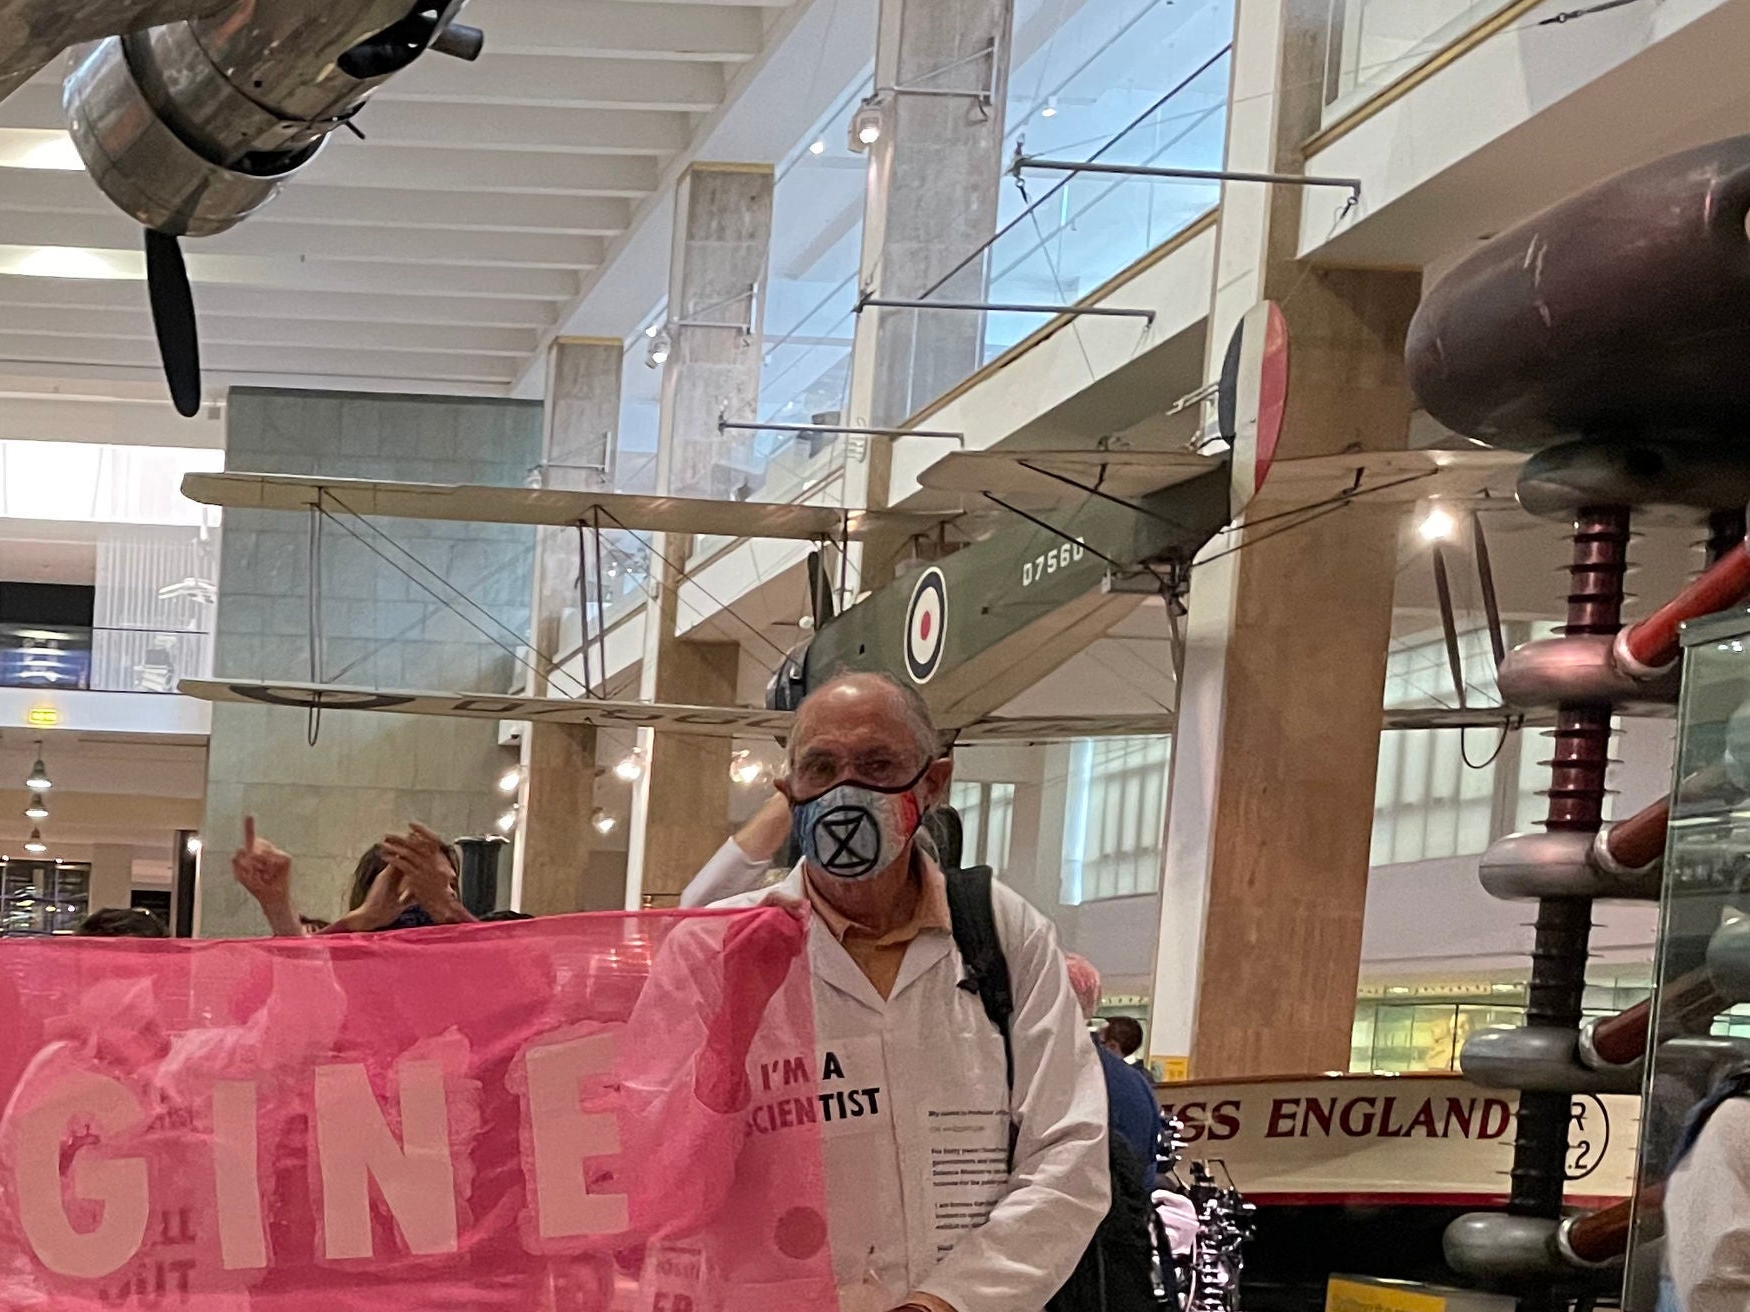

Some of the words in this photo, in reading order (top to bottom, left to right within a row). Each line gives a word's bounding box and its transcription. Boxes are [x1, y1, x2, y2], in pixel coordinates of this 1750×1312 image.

[761, 1057, 810, 1091] I'M
[823, 1052, 845, 1081] A
[1265, 1097, 1510, 1139] ENGLAND
